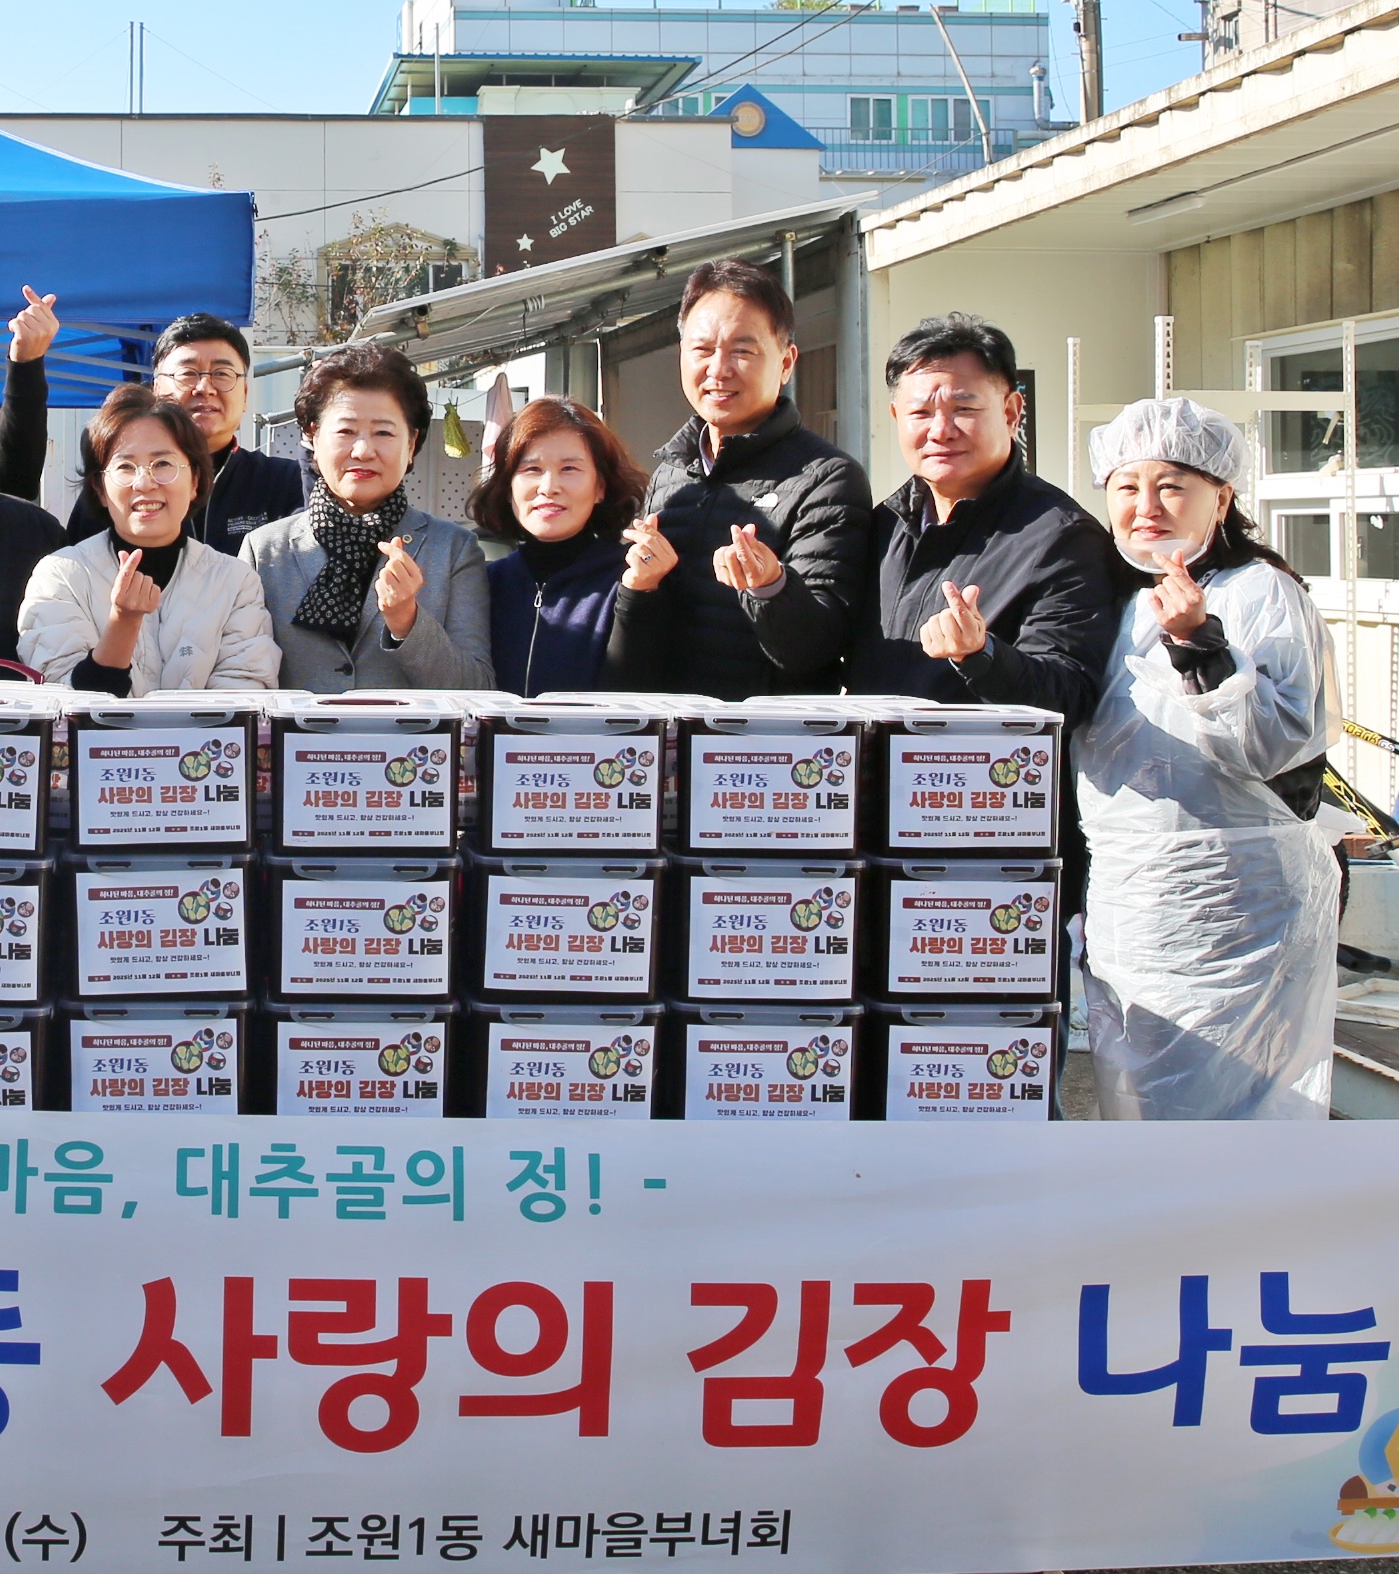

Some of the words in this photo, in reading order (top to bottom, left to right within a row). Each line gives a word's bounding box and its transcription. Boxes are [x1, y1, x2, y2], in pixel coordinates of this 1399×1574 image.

[550, 215, 558, 225] I
[558, 199, 584, 220] LOVE
[549, 222, 568, 238] BIG
[568, 205, 594, 226] STAR
[100, 767, 156, 782] 조원1동
[305, 771, 362, 785] 조원1동
[515, 773, 571, 787] 조원1동
[713, 773, 769, 787] 조원1동
[912, 772, 967, 786] 조원1동
[98, 786, 152, 805] 사랑의
[160, 785, 197, 803] 김장
[204, 784, 240, 802] 나눔
[303, 790, 358, 808] 사랑의
[365, 790, 403, 807] 김장
[409, 791, 445, 808] 나눔
[513, 792, 567, 809] 사랑의
[574, 792, 611, 809] 김장
[617, 792, 652, 809] 나눔
[711, 792, 764, 809] 사랑의
[772, 792, 809, 809] 김장
[815, 792, 850, 810] 나눔
[910, 791, 963, 808] 사랑의
[970, 791, 1006, 808] 김장
[1012, 791, 1047, 808] 나눔
[99, 909, 156, 925] 조원1동
[304, 918, 361, 932] 조원1동
[509, 914, 565, 929] 조원1동
[712, 914, 768, 930] 조원1동
[912, 918, 968, 932] 조원1동
[98, 929, 152, 950] 사랑의
[159, 928, 197, 948] 김장
[204, 927, 239, 946] 나눔
[302, 937, 356, 955] 사랑의
[364, 937, 401, 955] 김장
[408, 938, 444, 955] 나눔
[506, 933, 560, 952] 사랑의
[567, 935, 604, 952] 김장
[610, 936, 646, 953] 나눔
[710, 935, 763, 954] 사랑의
[770, 935, 808, 954] 김장
[814, 936, 849, 954] 나눔
[910, 937, 963, 954] 사랑의
[970, 937, 1007, 954] 김장
[1013, 937, 1048, 954] 나눔
[92, 1057, 148, 1073] 조원1동
[299, 1060, 356, 1075] 조원1동
[510, 1061, 566, 1077] 조원1동
[708, 1062, 764, 1078] 조원1동
[910, 1063, 965, 1077] 조원1동
[90, 1078, 144, 1097] 사랑의
[152, 1077, 189, 1096] 김장
[196, 1077, 232, 1096] 나눔
[297, 1080, 351, 1099] 사랑의
[358, 1080, 396, 1099] 김장
[403, 1080, 438, 1099] 나눔
[507, 1081, 561, 1101] 사랑의
[568, 1082, 605, 1101] 김장
[611, 1083, 647, 1102] 나눔
[706, 1083, 760, 1102] 사랑의
[767, 1083, 804, 1102] 김장
[810, 1084, 846, 1103] 나눔
[907, 1082, 960, 1099] 사랑의
[967, 1082, 1003, 1100] 김장
[1009, 1083, 1044, 1100] 나눔
[176, 1144, 466, 1223] 대추골의
[506, 1148, 602, 1224] 정!
[100, 1275, 614, 1454] 사랑의
[687, 1279, 1012, 1448] 김장
[1078, 1271, 1391, 1435] 나눔
[158, 1515, 254, 1563] 주최
[305, 1515, 484, 1562] 조원1동
[502, 1510, 792, 1560] 새마을부녀회
